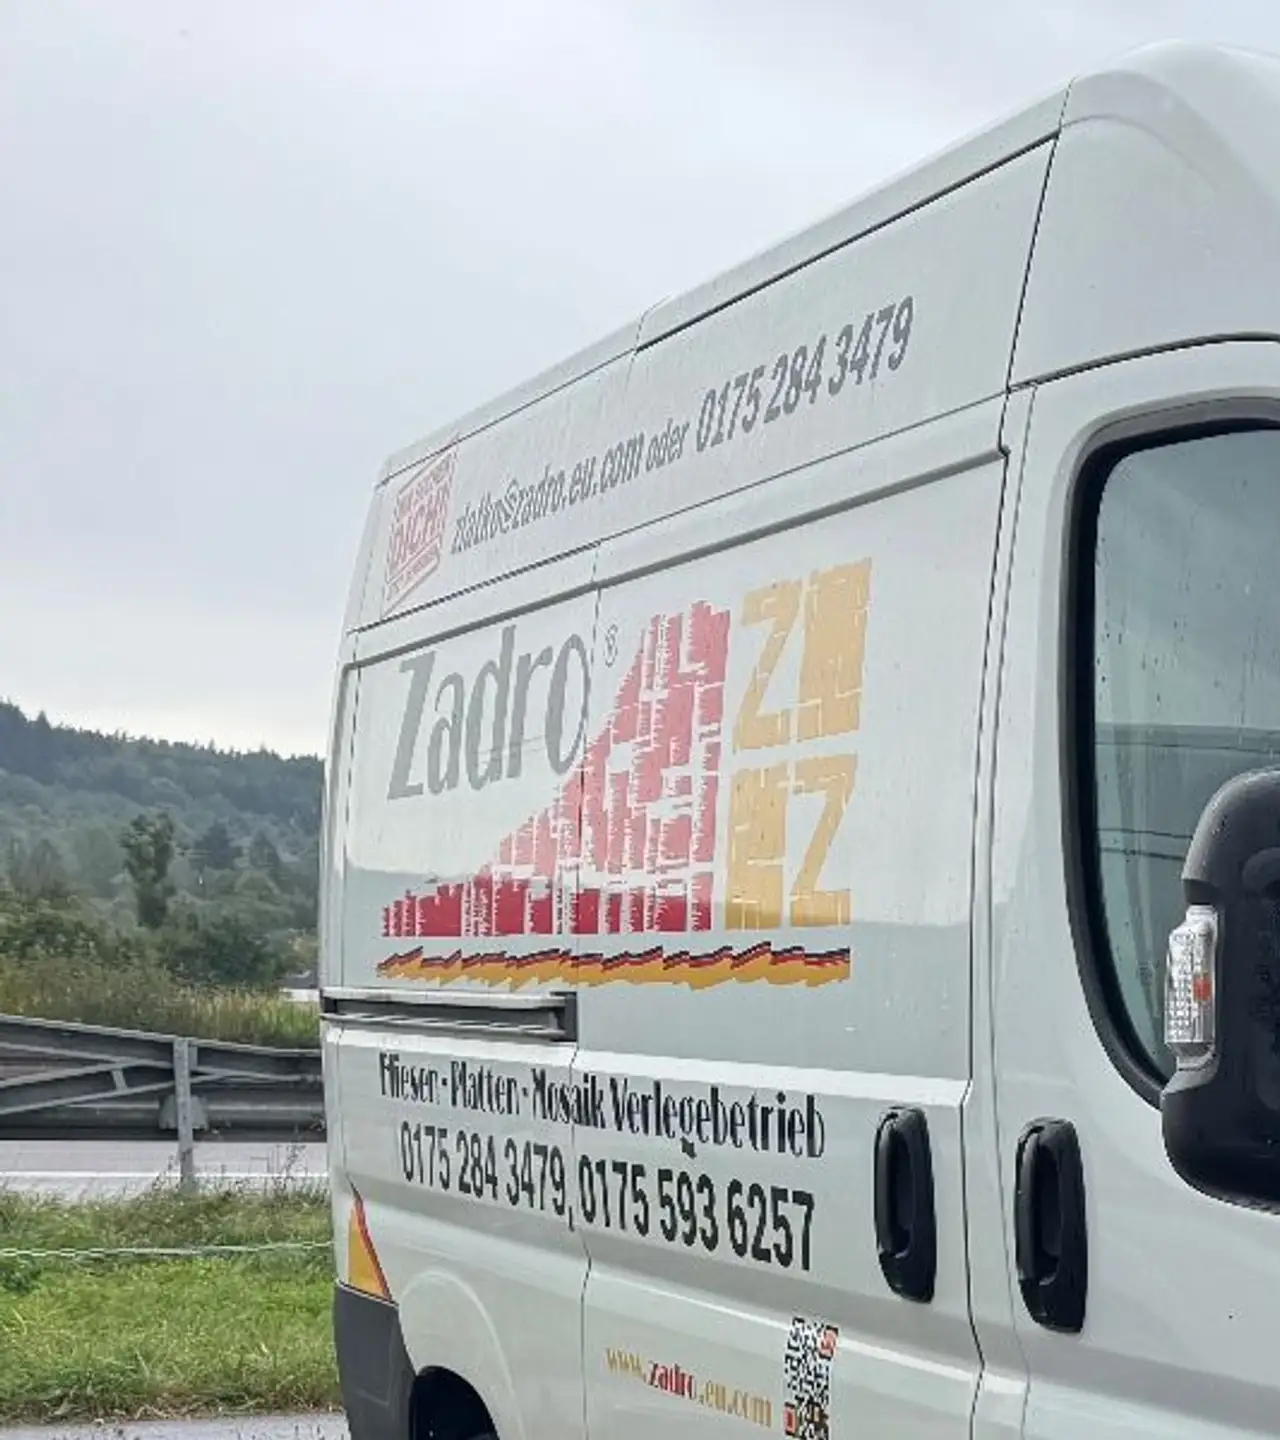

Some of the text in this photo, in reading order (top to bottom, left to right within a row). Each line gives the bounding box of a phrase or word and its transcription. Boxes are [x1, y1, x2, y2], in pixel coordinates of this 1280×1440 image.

[646, 418, 690, 472] oder
[696, 365, 767, 452] 0175
[763, 333, 827, 424] 284
[828, 295, 914, 396] 3479
[609, 1077, 825, 1159] Verlegebetrieb
[400, 1121, 815, 1270] 0175 284 3479, 0175 593 6257
